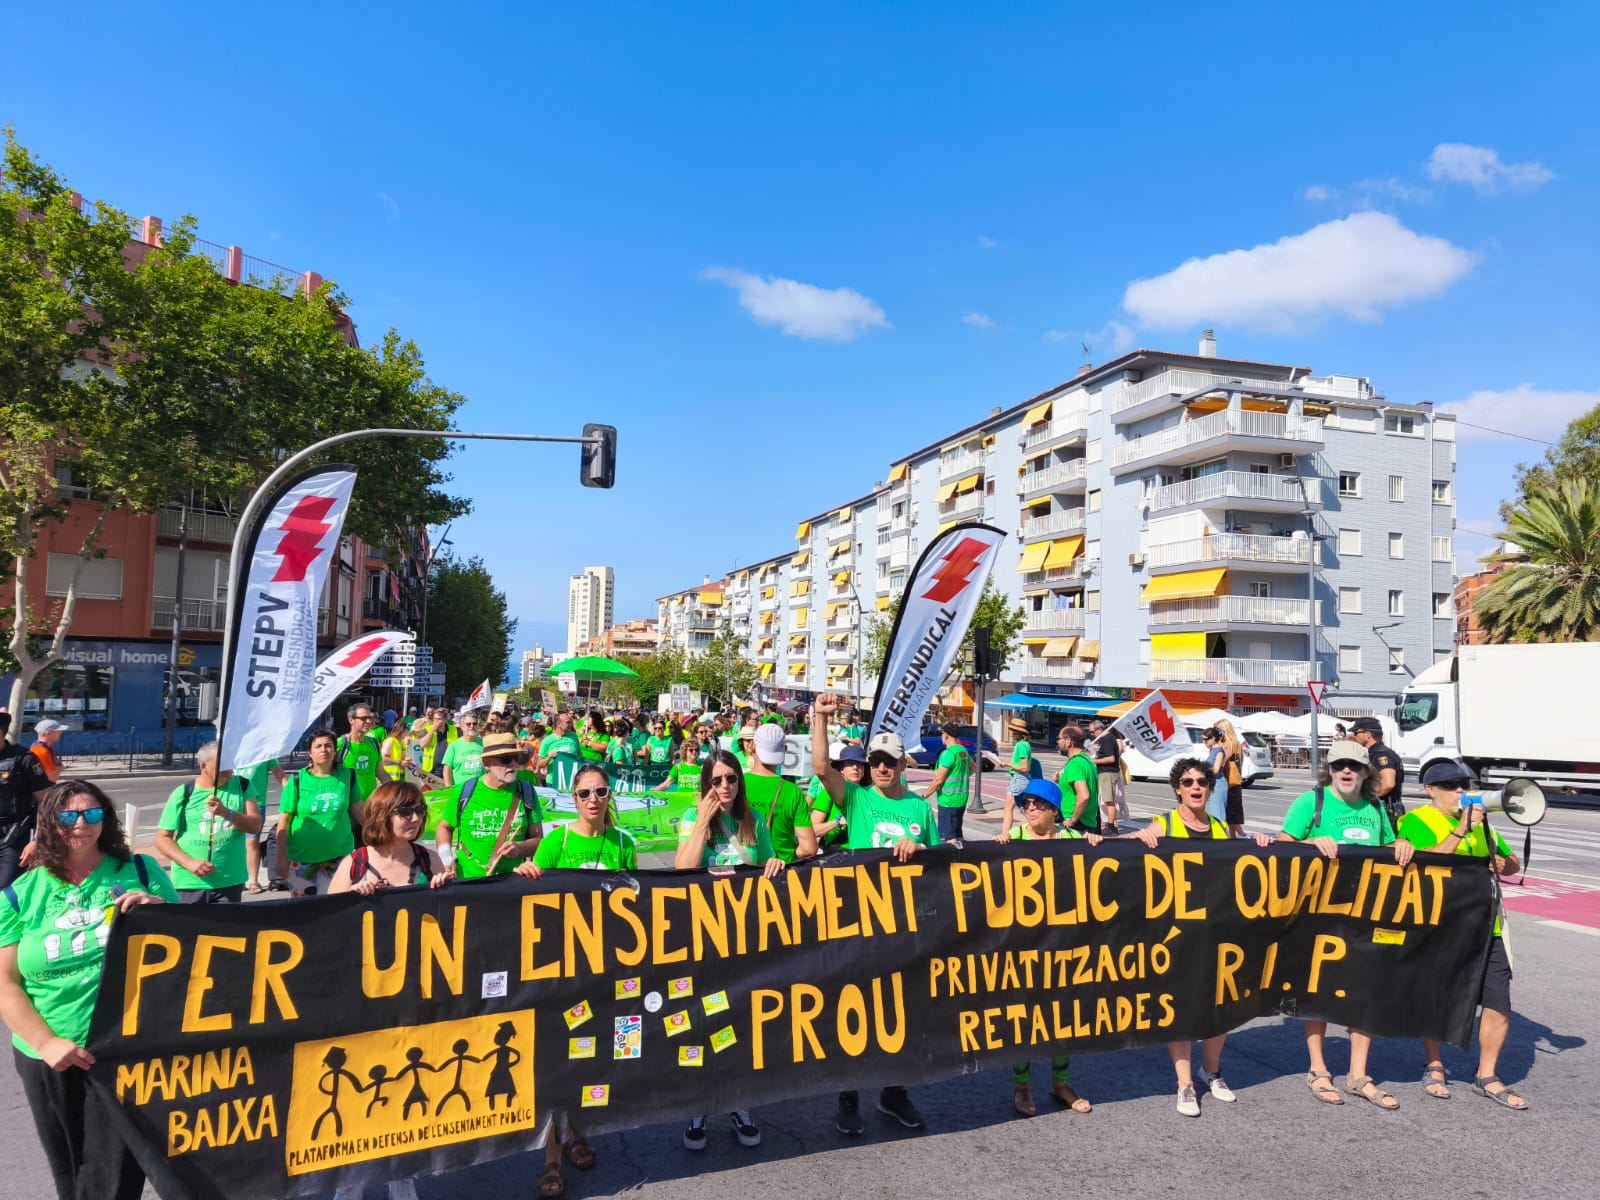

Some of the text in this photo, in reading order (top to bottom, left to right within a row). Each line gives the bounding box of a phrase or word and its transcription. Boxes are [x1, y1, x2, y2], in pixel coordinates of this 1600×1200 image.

[121, 649, 168, 664] home
[246, 591, 289, 700] STEPV
[876, 607, 957, 735] NTERSINDICAL
[1133, 715, 1165, 752] STEPV
[122, 852, 1453, 1036] PER UN ENSENYAMENT PUBLIC DE QUALITAT
[930, 925, 1181, 998] PRIVATITZACIÓ
[751, 972, 906, 1070] PROU
[960, 993, 1175, 1053] RETALLADES
[116, 1046, 254, 1105] MARINA
[168, 1095, 278, 1157] BAIXA
[289, 1139, 355, 1167] PLATAFORMA
[356, 1138, 369, 1153] EN
[373, 1129, 415, 1150] DEFENSA
[418, 1126, 429, 1141] DE
